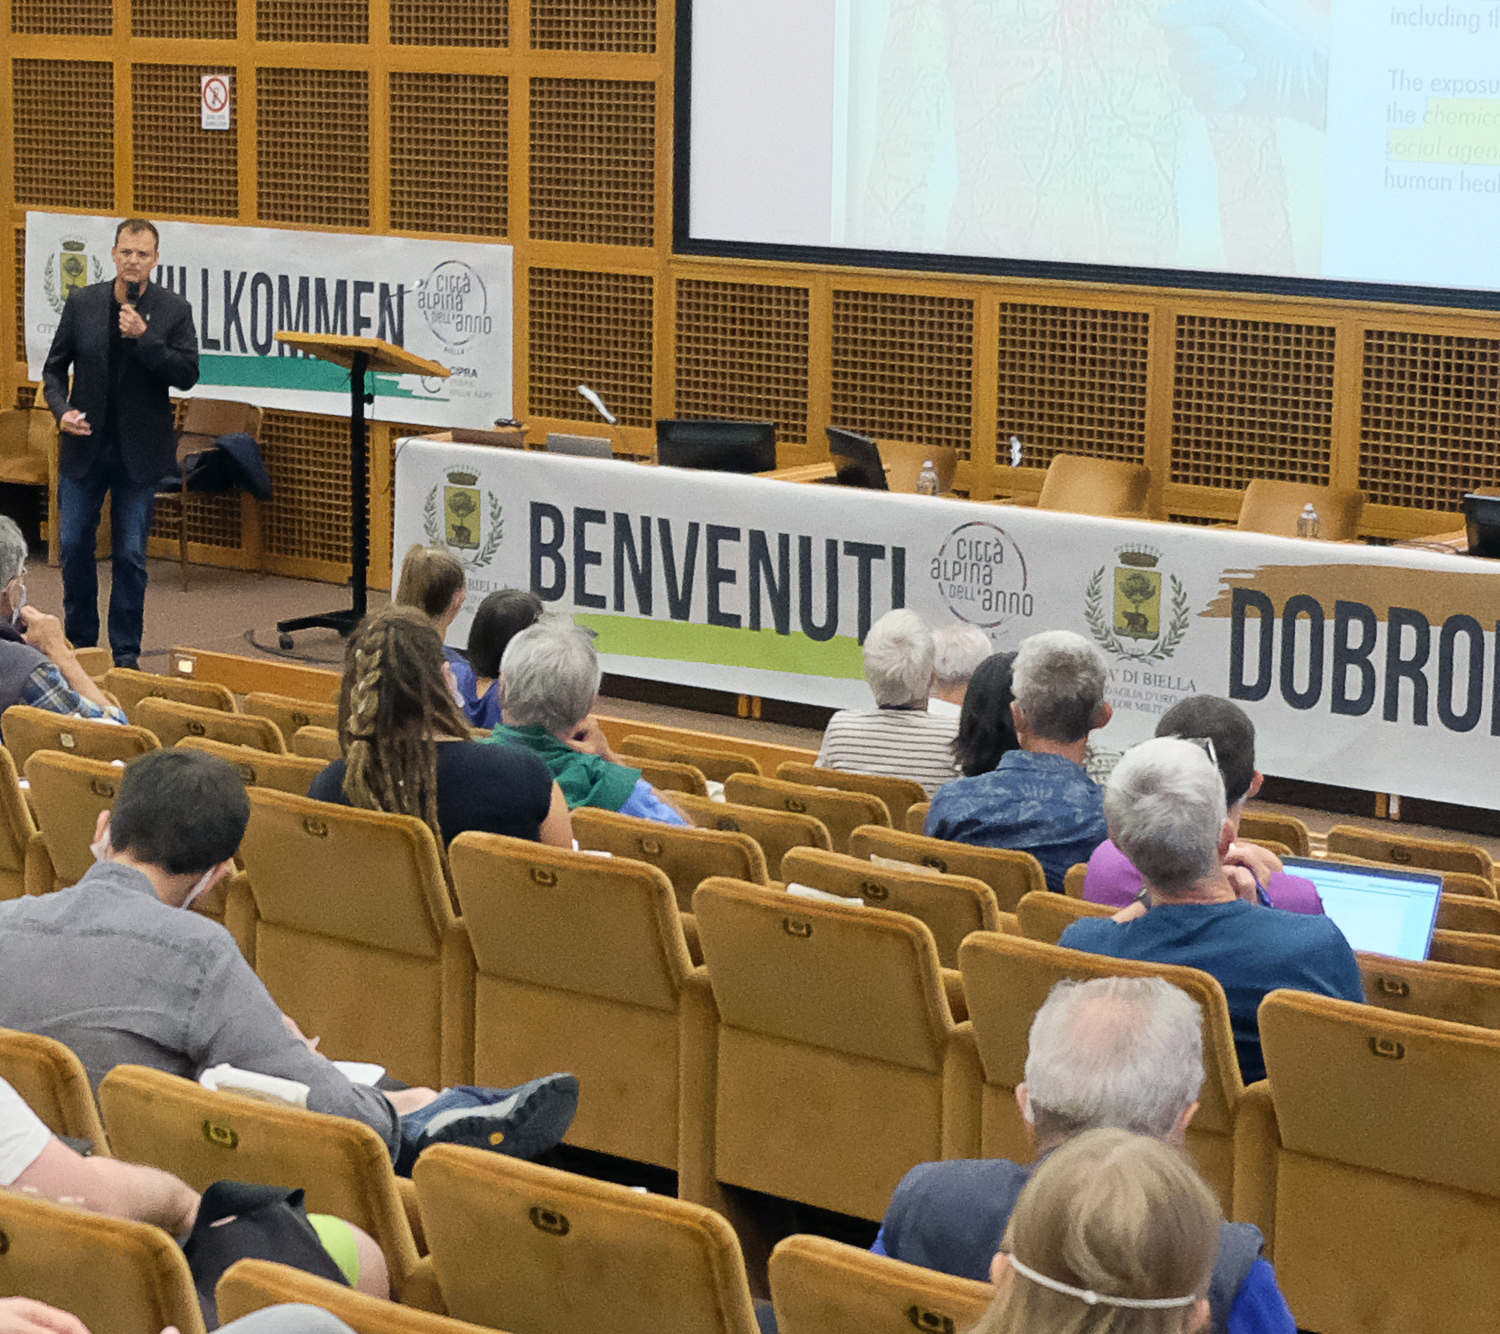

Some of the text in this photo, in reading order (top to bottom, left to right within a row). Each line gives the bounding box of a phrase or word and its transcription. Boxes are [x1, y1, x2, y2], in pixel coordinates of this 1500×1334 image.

[1390, 5, 1480, 34] including
[1388, 69, 1424, 91] The
[1386, 102, 1416, 124] the
[1385, 136, 1441, 156] social
[1384, 167, 1452, 192] human
[530, 501, 906, 646] BENVENUTI
[1123, 669, 1138, 684] DI
[1143, 672, 1196, 692] BIELLA
[1105, 685, 1144, 700] DAGLIA
